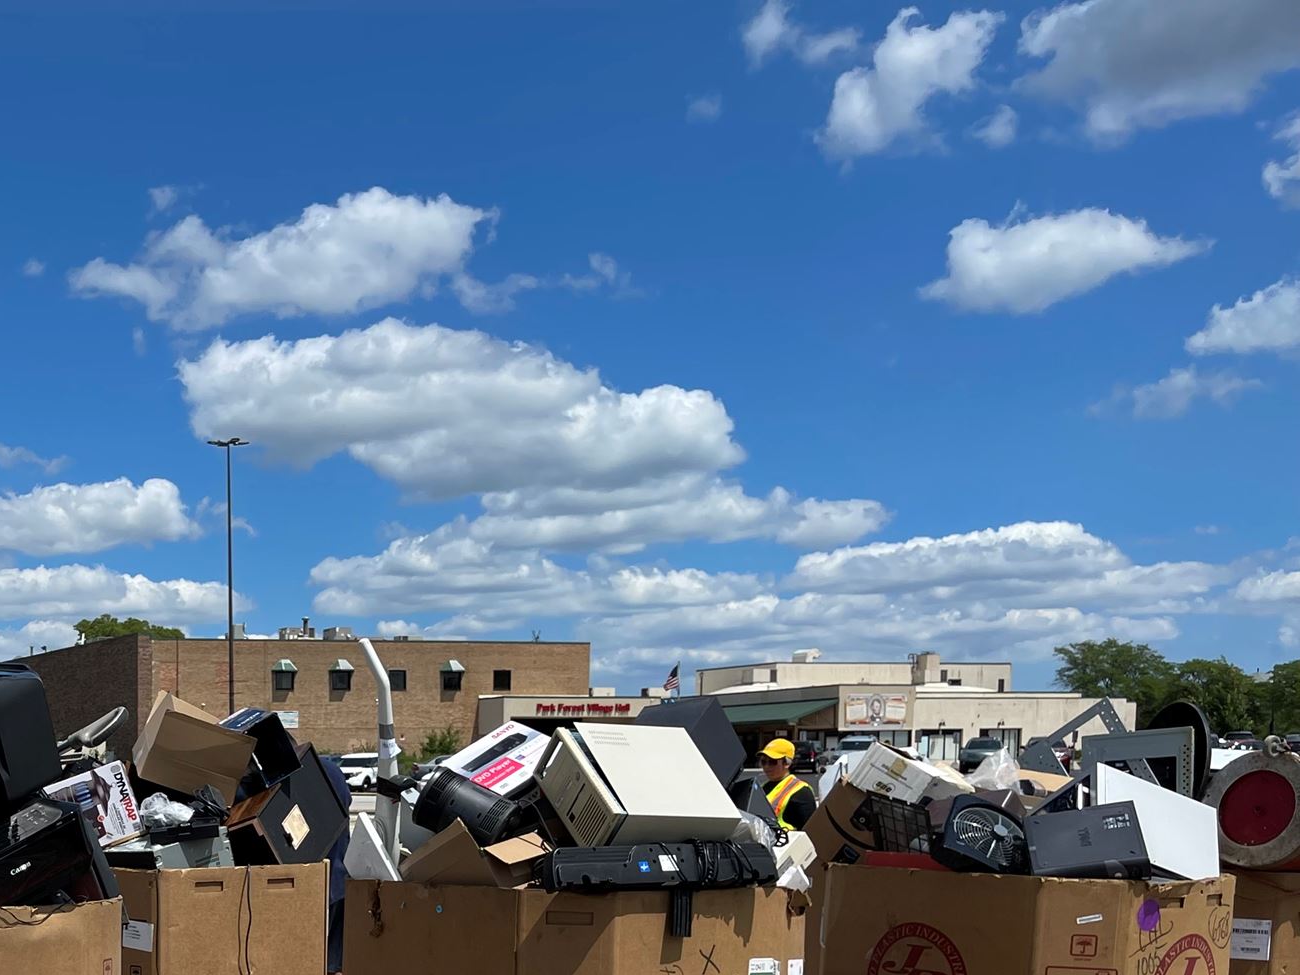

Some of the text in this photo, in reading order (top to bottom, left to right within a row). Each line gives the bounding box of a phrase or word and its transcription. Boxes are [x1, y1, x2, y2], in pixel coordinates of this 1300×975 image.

[536, 703, 631, 714] Park Forest Village Hall
[491, 723, 515, 740] SANYO
[474, 770, 492, 783] DVD
[491, 759, 511, 774] Player
[113, 771, 138, 822] DYNATRAP
